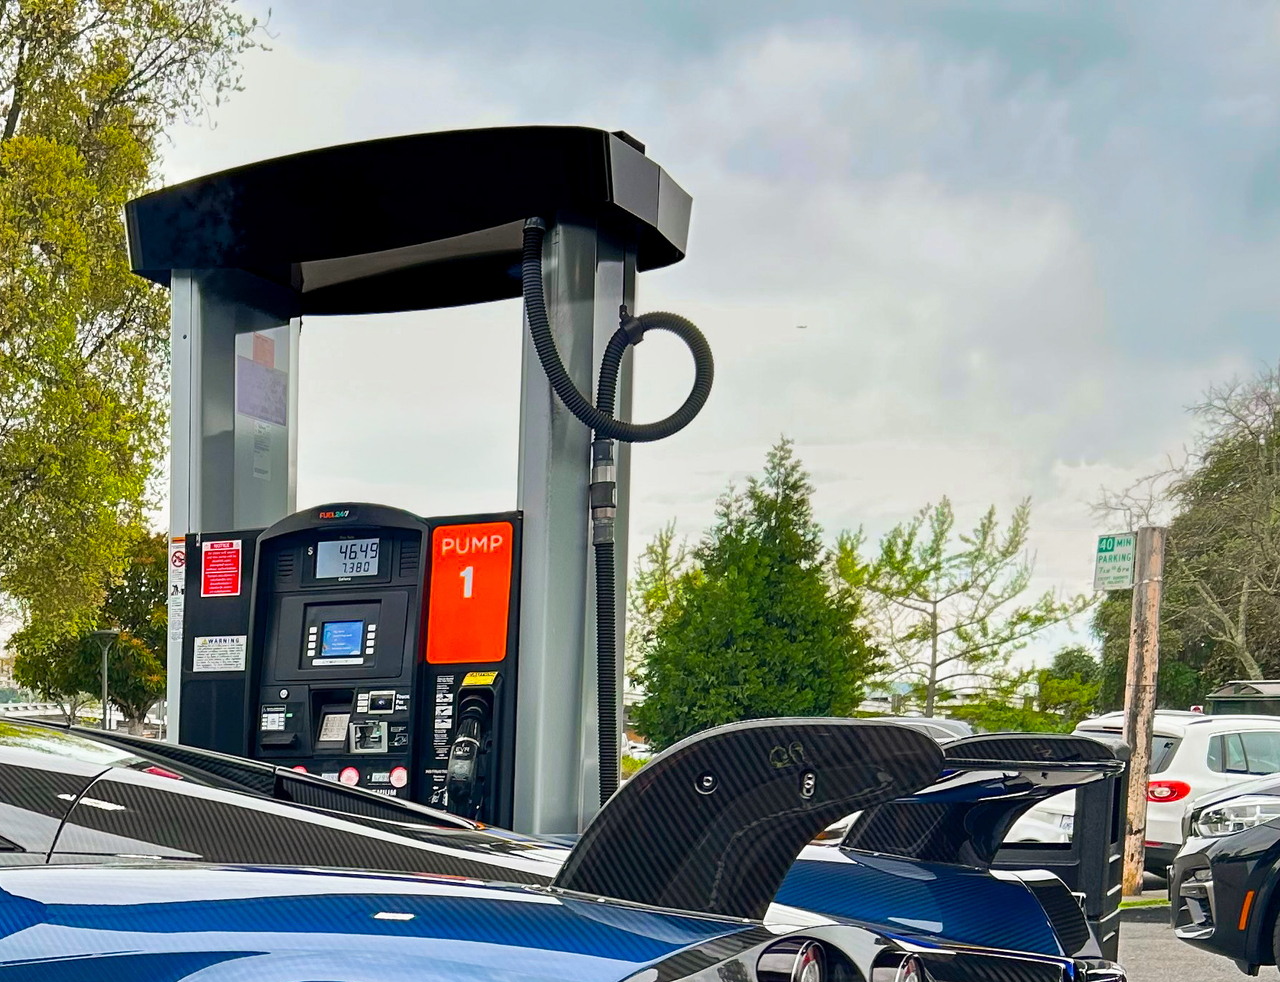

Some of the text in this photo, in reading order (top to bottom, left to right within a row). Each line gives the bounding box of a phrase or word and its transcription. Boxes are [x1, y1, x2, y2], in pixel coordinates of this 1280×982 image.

[441, 534, 503, 556] PUMP
[1099, 538, 1132, 550] 40 MIN
[307, 546, 314, 555] $
[1098, 553, 1132, 564] PARKING
[459, 565, 474, 599] 1
[208, 637, 240, 645] WARNING
